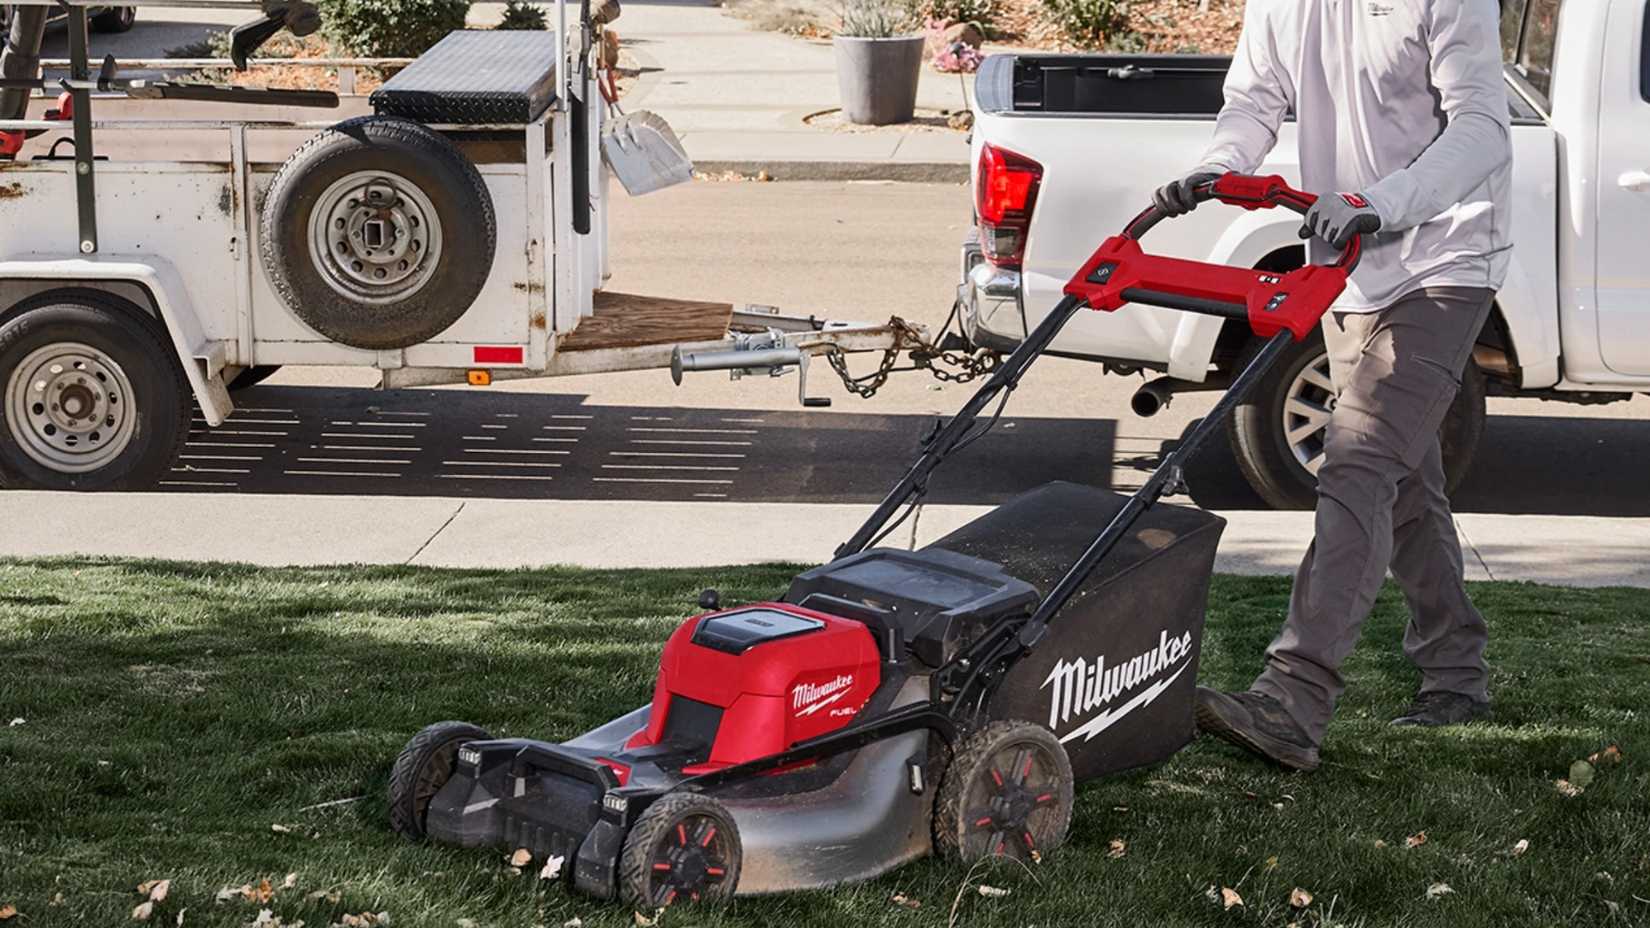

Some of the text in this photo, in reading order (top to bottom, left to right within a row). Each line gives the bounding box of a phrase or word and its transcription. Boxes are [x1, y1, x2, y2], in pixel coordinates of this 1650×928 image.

[792, 674, 854, 709] Milwaukee
[1039, 630, 1193, 730] Milwaukee
[830, 707, 857, 717] FUEL
